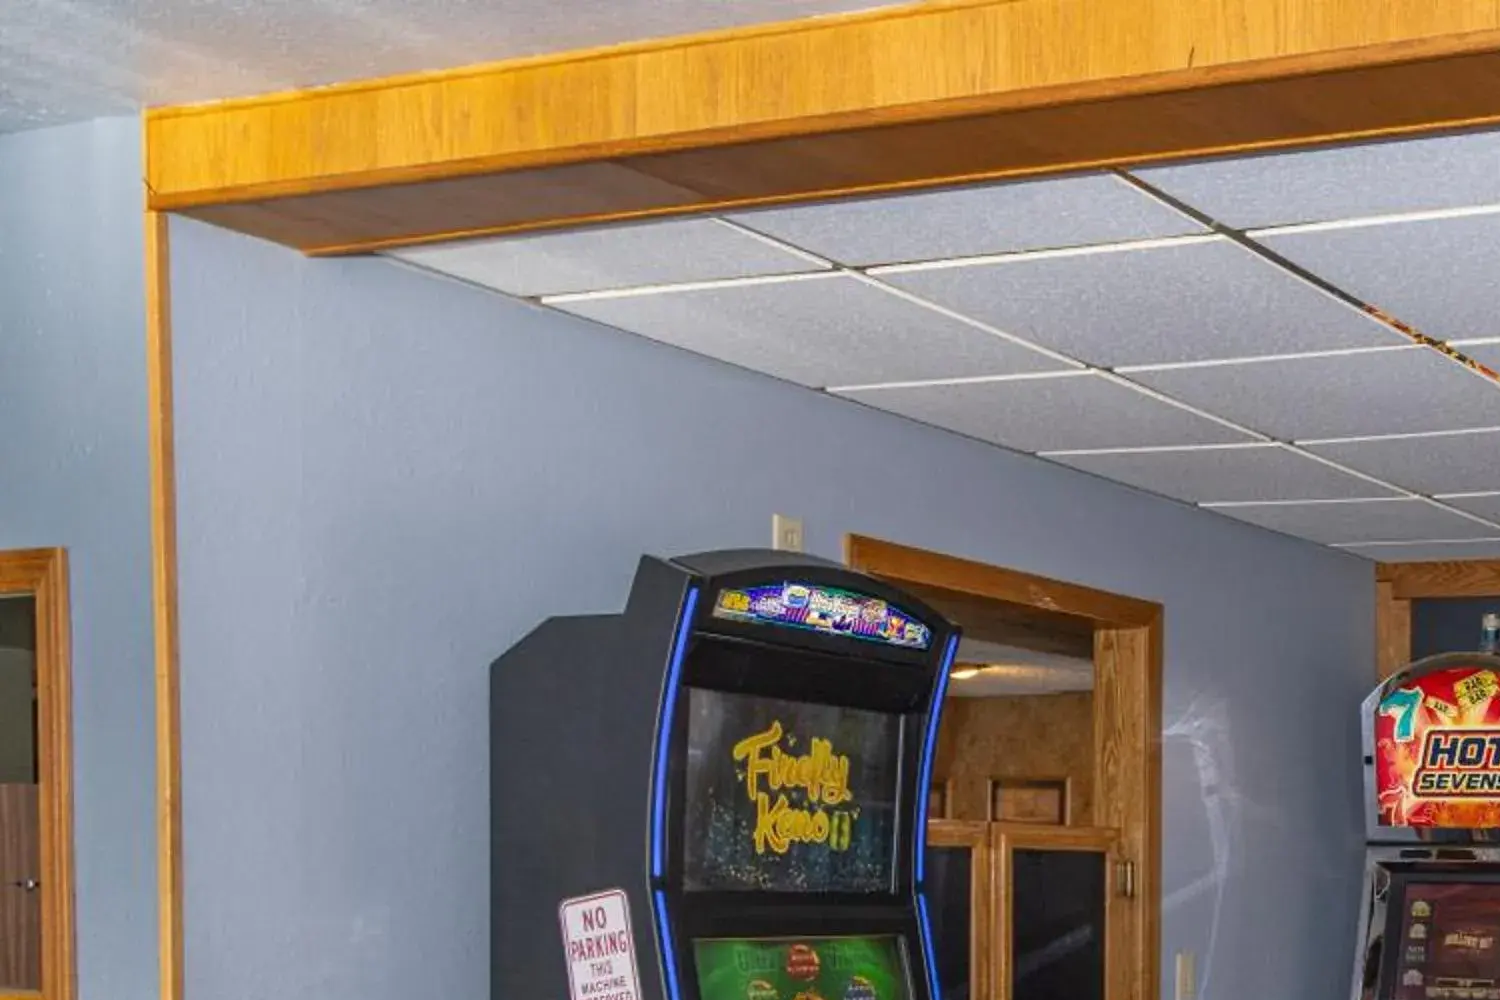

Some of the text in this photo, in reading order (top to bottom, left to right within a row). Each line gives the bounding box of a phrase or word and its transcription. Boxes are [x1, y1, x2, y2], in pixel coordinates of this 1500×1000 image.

[754, 792, 829, 855] Keno
[581, 906, 608, 932] NO
[570, 930, 628, 960] PARKING
[589, 960, 614, 977] THIS
[581, 975, 627, 995] MACHINE
